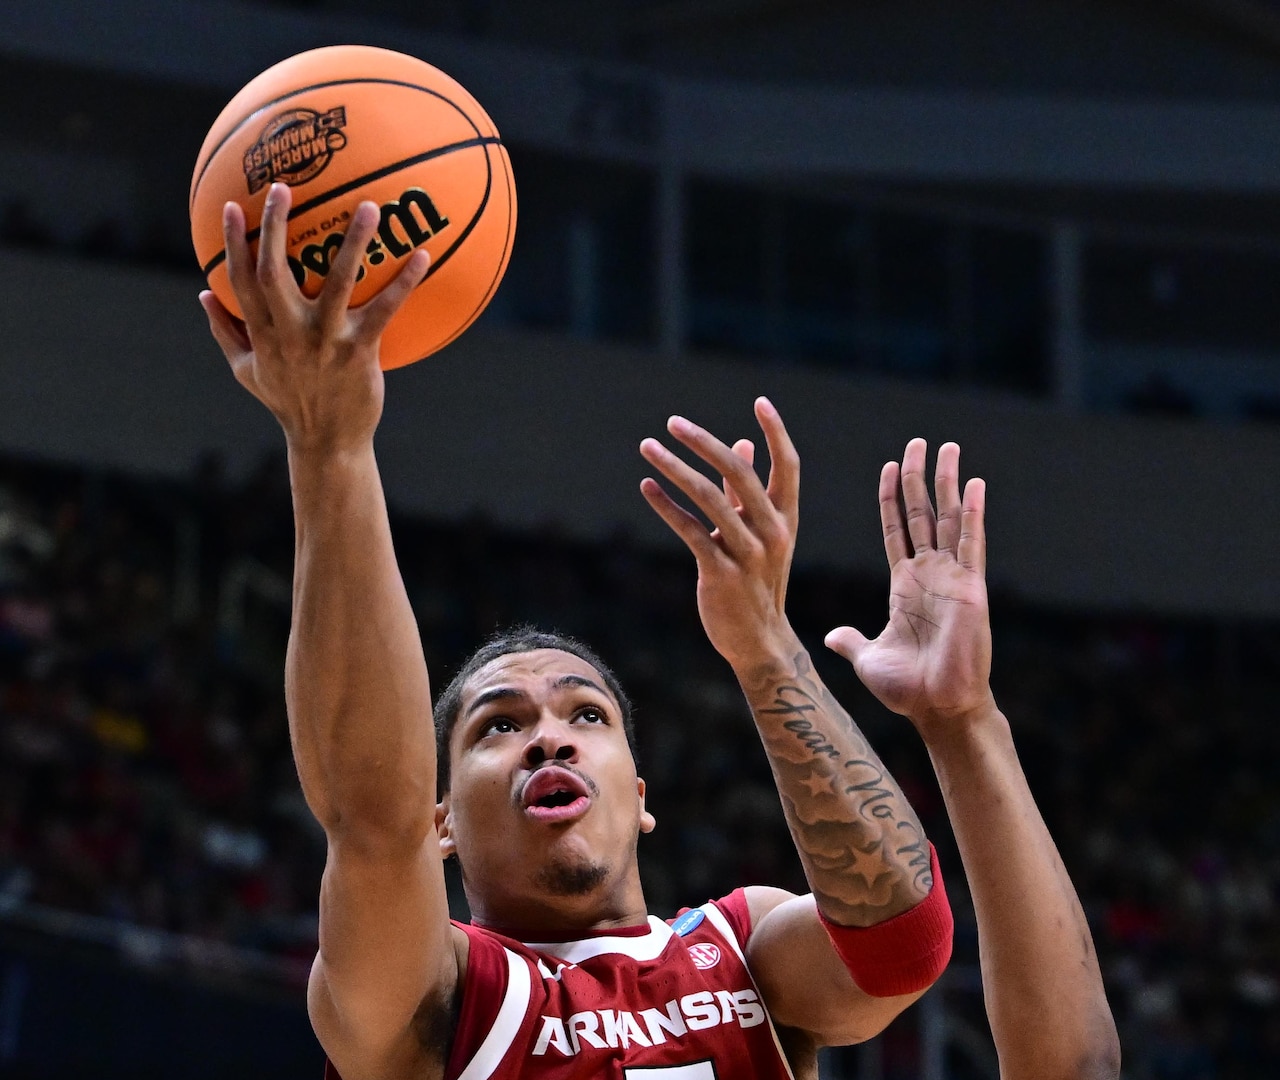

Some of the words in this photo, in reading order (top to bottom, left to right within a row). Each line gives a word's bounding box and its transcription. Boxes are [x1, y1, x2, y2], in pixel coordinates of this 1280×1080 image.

[243, 125, 315, 173] MADNESS
[272, 137, 326, 175] MARCH
[759, 686, 841, 758] Fear
[845, 760, 896, 822] No
[532, 988, 766, 1056] ARKANSAS
